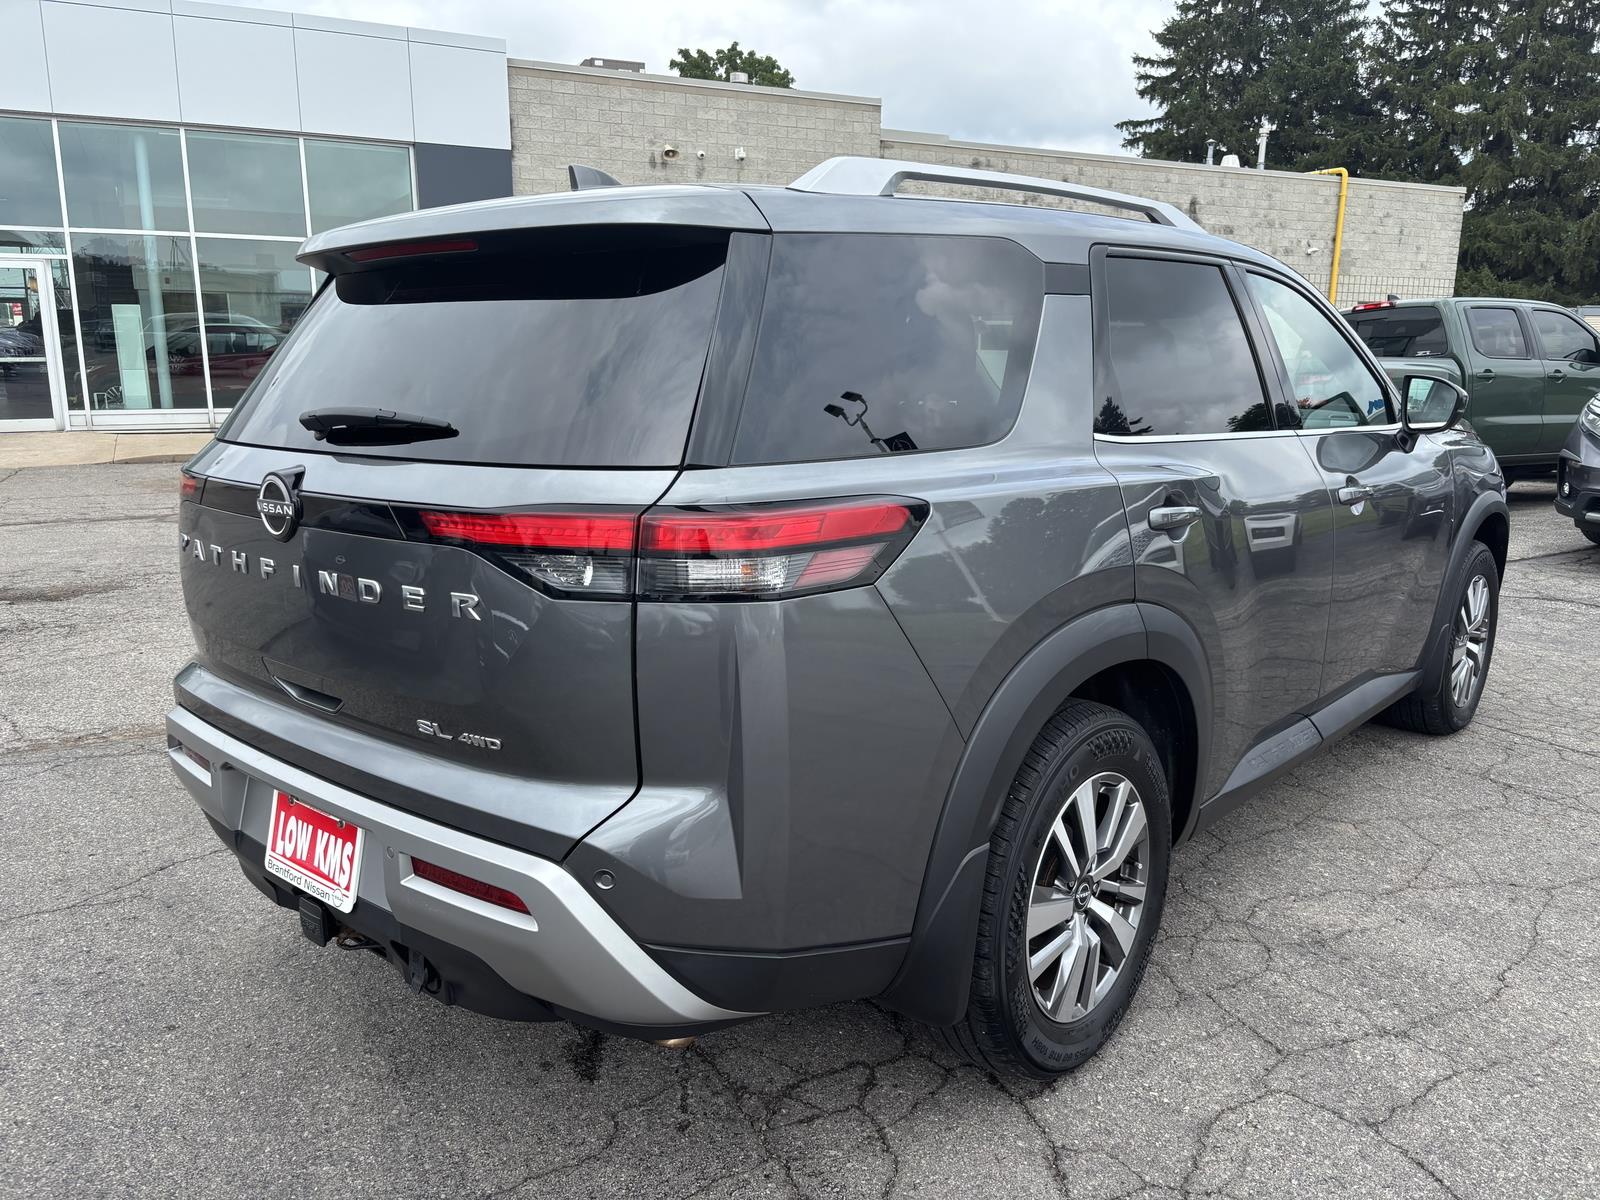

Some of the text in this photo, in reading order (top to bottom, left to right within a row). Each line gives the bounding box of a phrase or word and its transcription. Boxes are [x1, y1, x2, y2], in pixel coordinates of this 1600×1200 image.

[416, 719, 503, 751] SL 4WD
[276, 810, 354, 890] LOW KMS
[267, 858, 331, 901] Brantford Nissan
